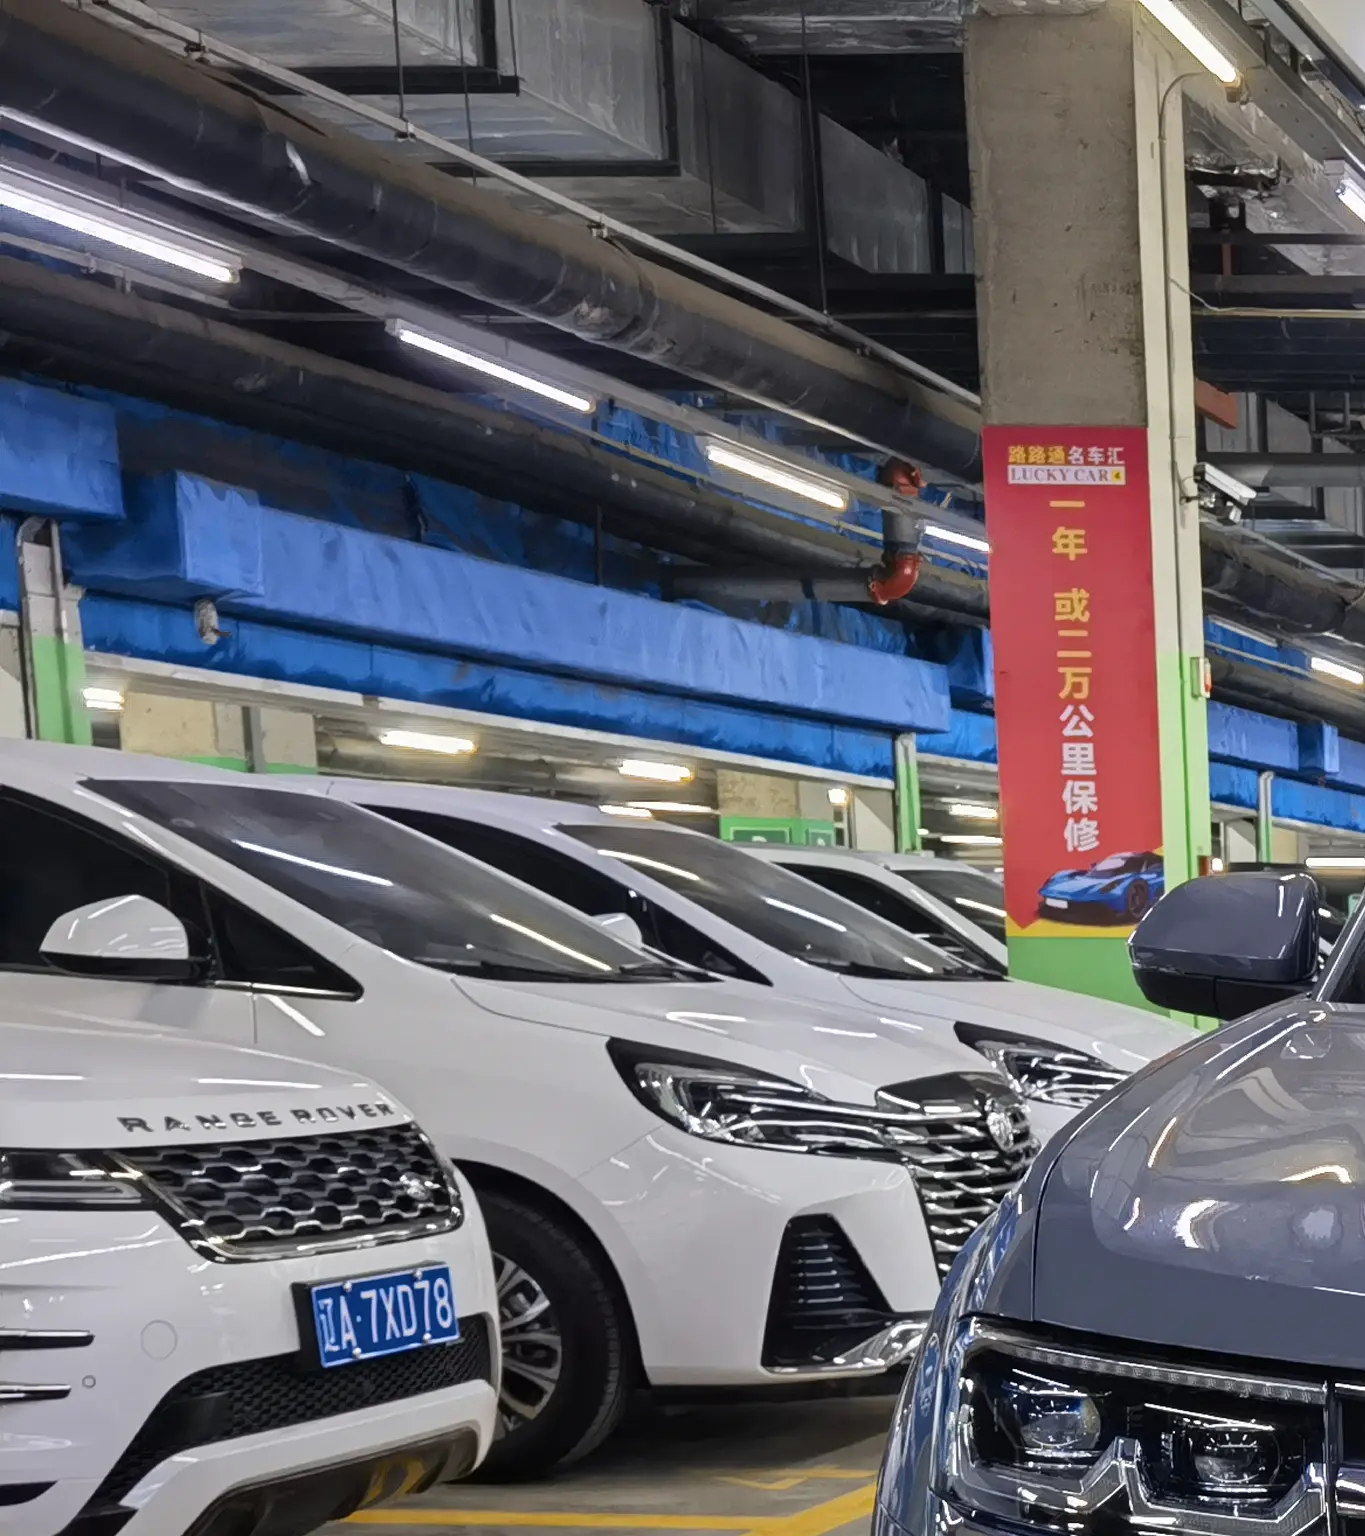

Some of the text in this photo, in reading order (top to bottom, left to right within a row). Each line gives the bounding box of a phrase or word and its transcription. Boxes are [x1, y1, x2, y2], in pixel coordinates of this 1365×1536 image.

[1008, 445, 1126, 465] 路路通名车汇
[1010, 467, 1109, 482] LUCKY CAR
[117, 1103, 395, 1133] RANGE ROVER
